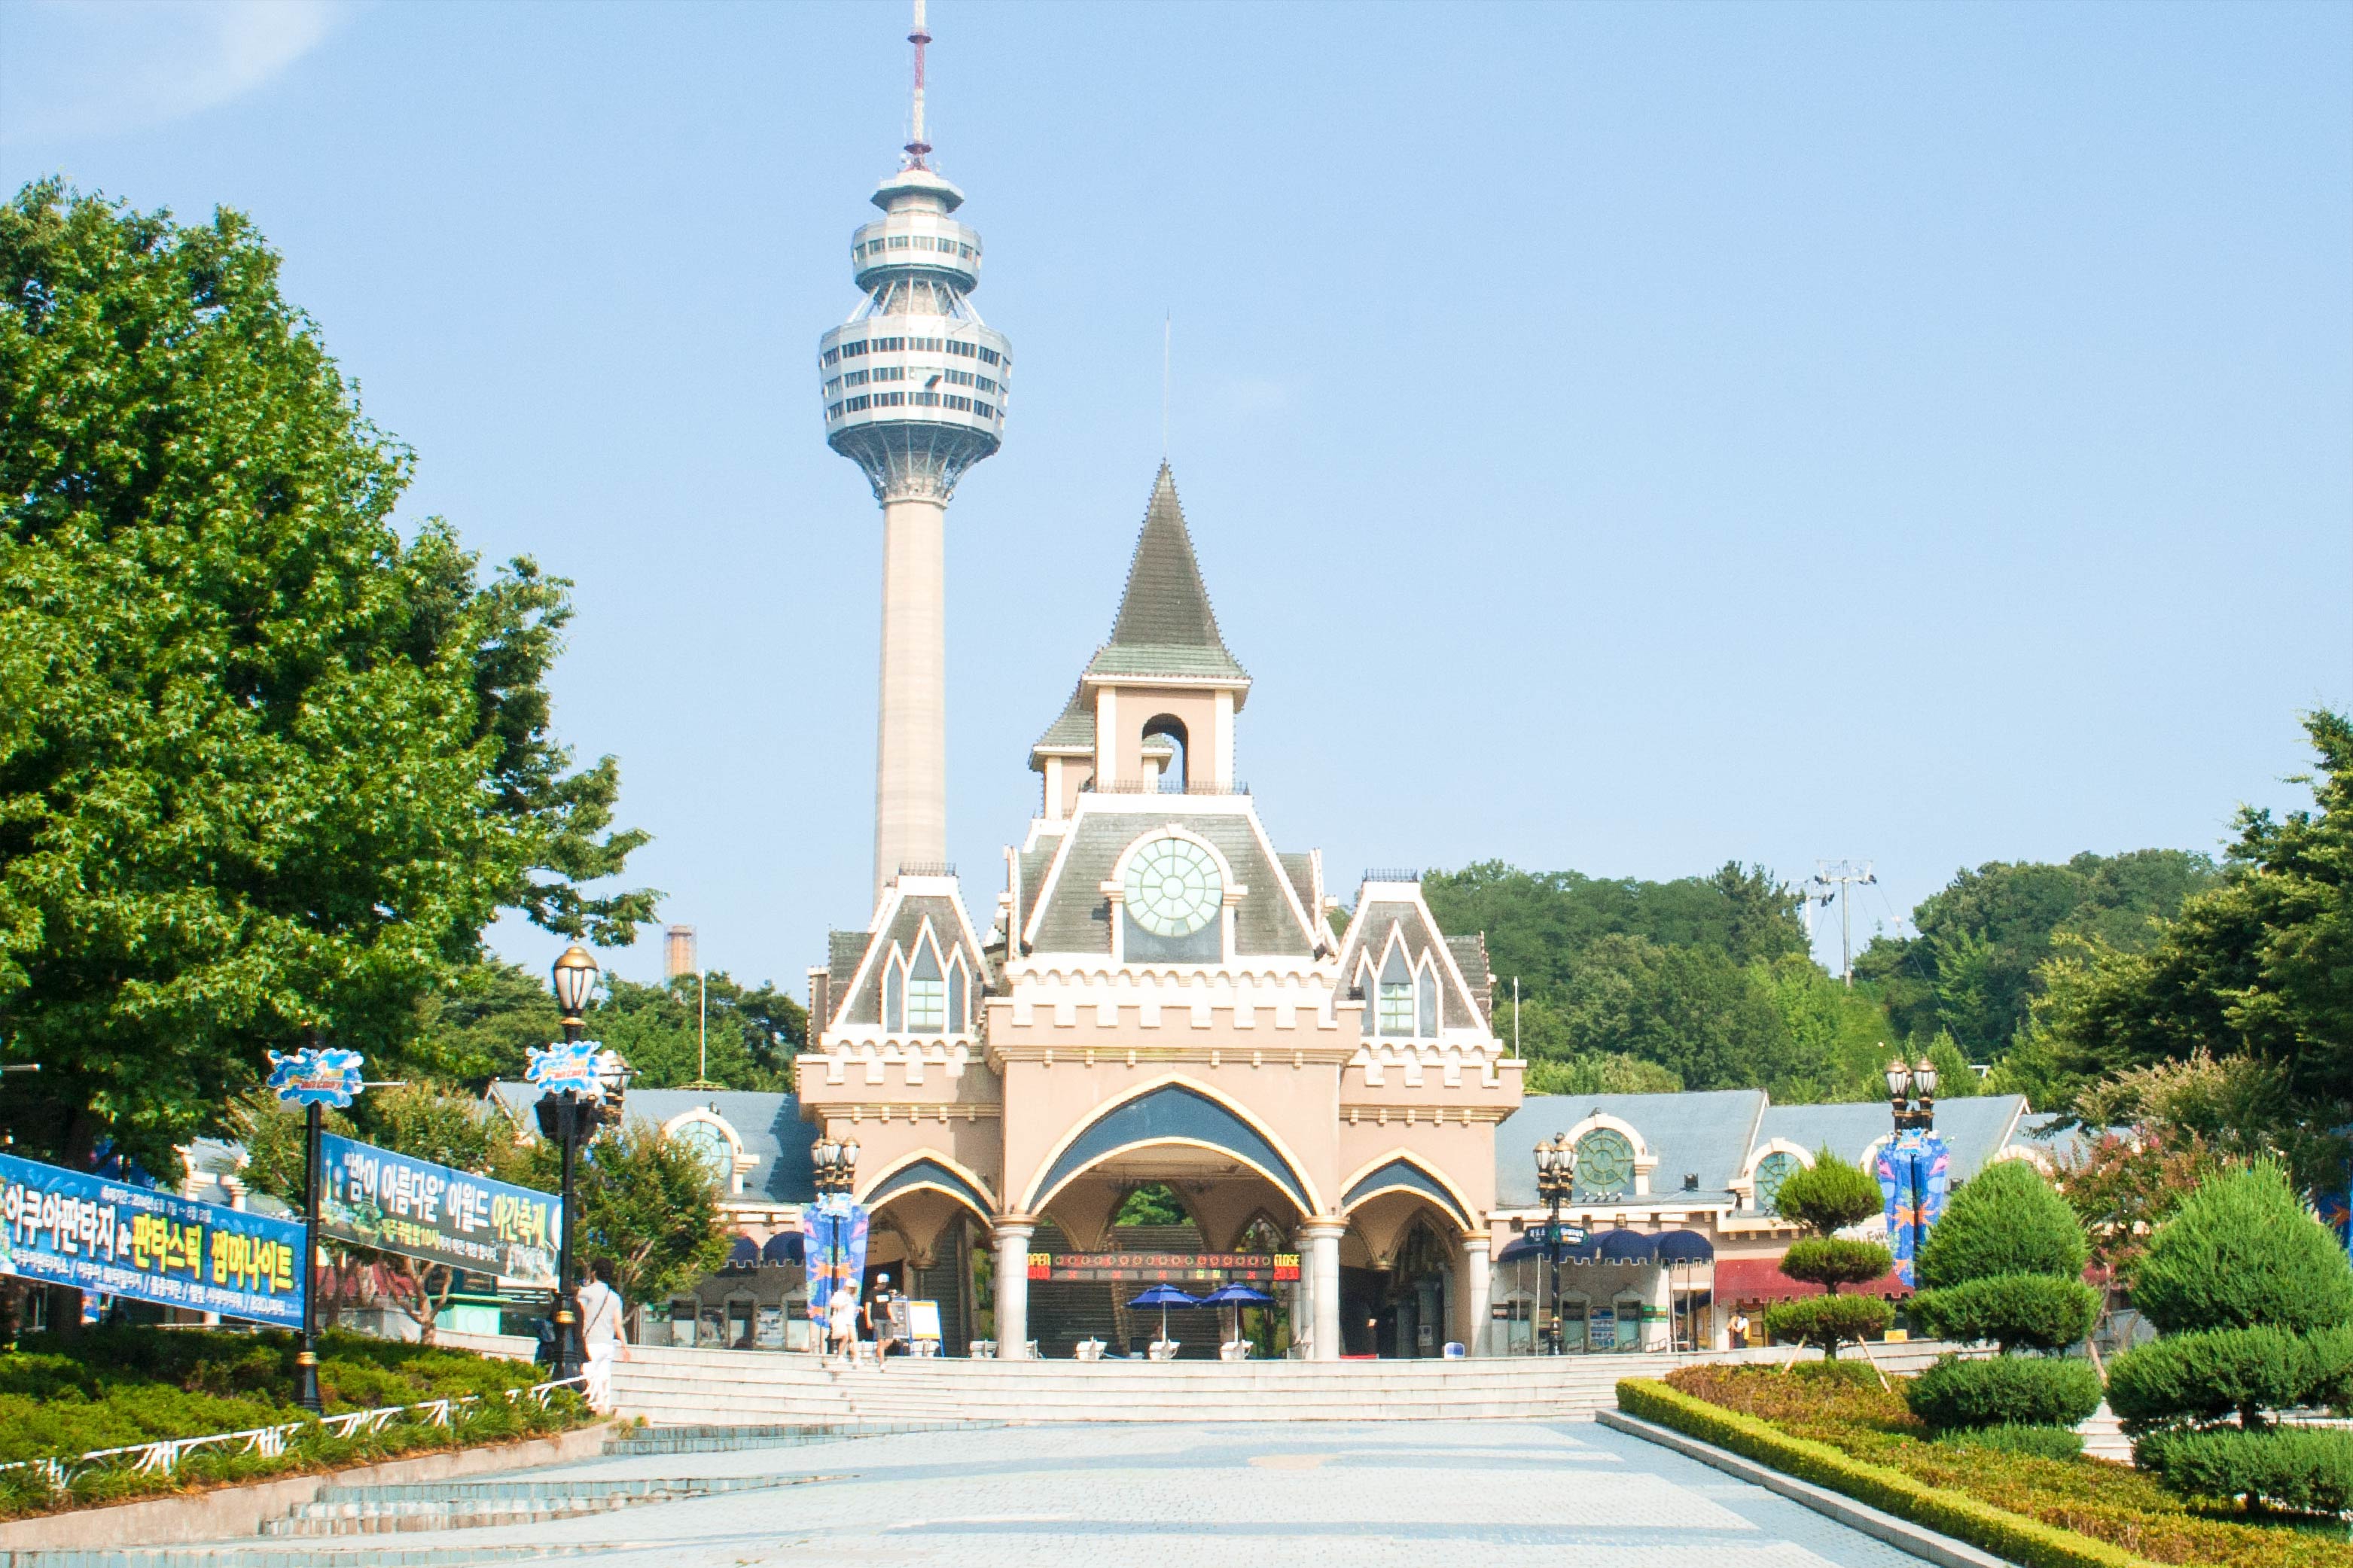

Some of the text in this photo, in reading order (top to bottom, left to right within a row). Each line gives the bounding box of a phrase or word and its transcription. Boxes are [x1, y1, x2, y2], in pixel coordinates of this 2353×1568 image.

[5, 1183, 116, 1262] 아쿠아판타지
[133, 1213, 203, 1280] 판타스틱
[447, 1181, 490, 1233] 이월드
[491, 1193, 547, 1249] 야간축제
[1274, 1253, 1300, 1266] CLOSE
